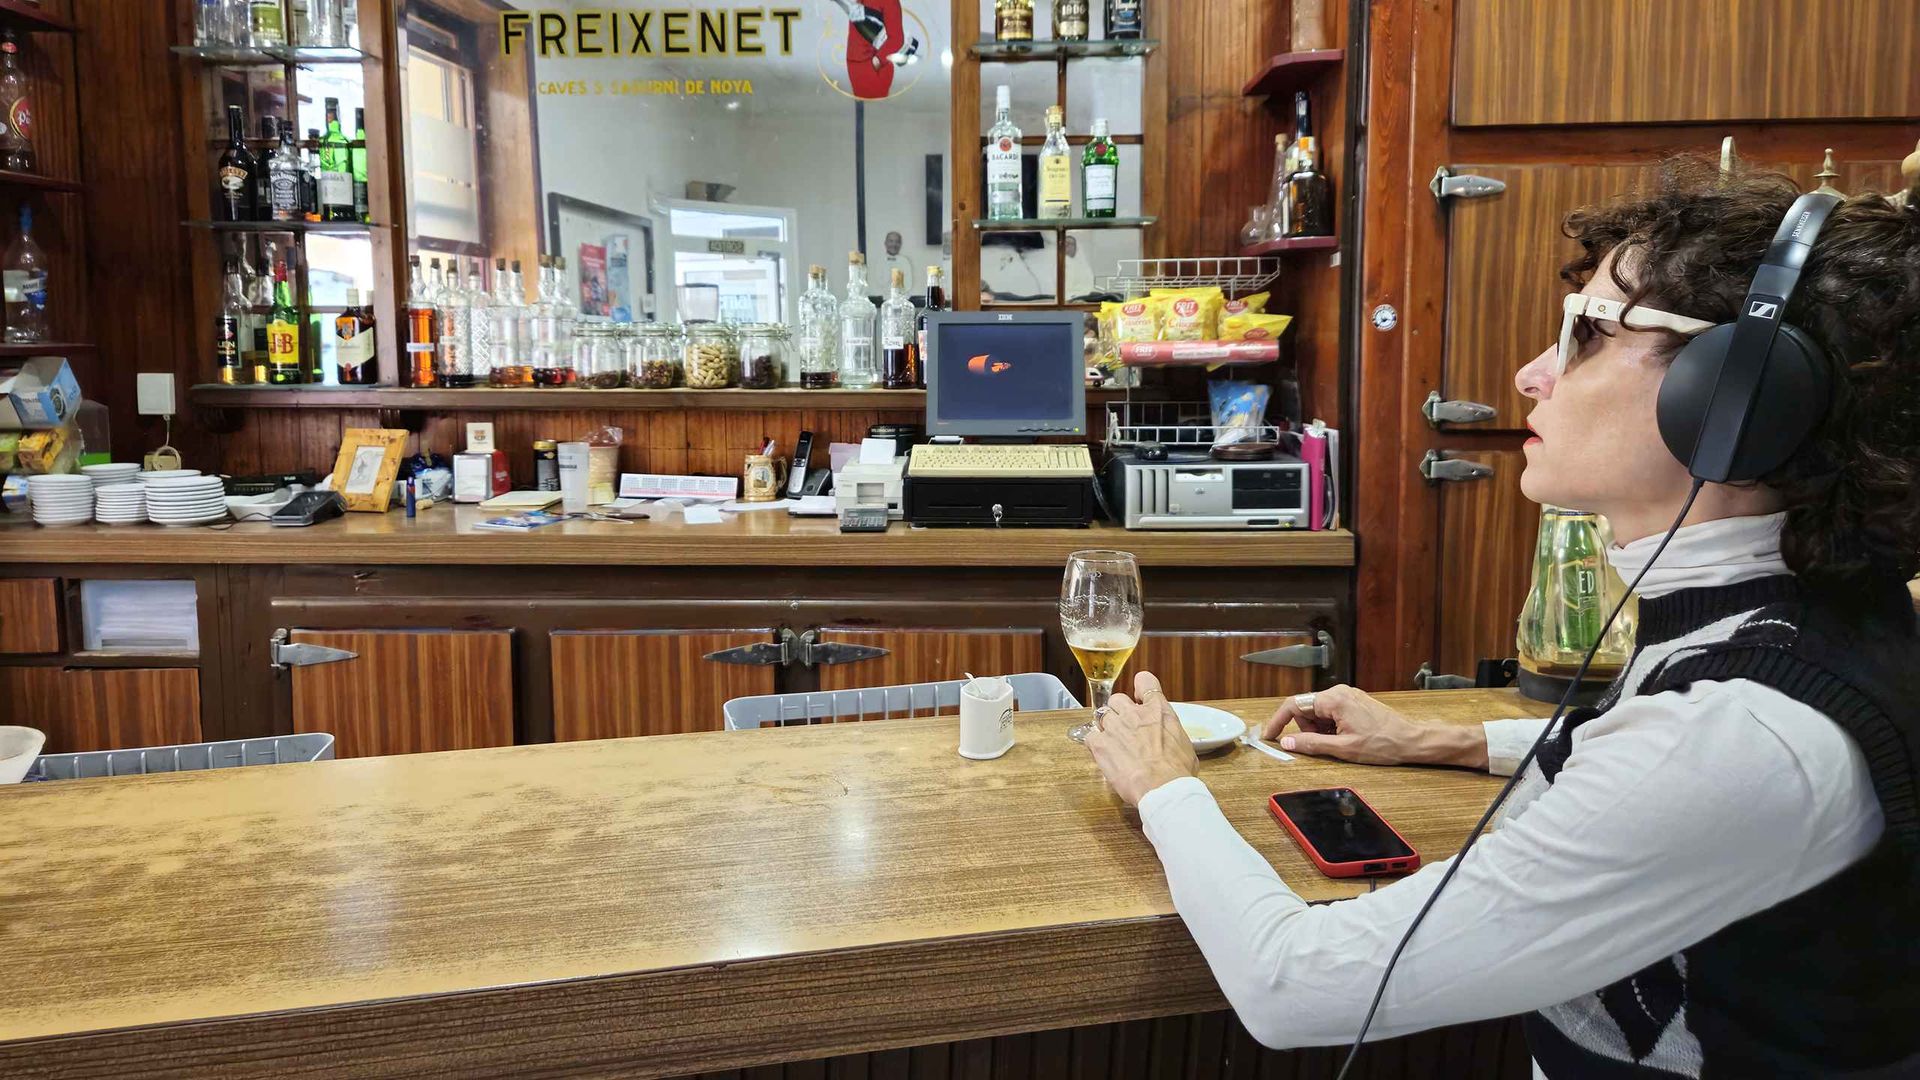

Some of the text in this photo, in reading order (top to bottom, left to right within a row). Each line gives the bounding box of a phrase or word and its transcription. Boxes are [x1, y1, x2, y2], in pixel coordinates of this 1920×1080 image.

[502, 9, 801, 57] FREIXENET
[538, 81, 587, 95] CAVES
[685, 79, 704, 95] DE
[710, 79, 753, 95] NOYA
